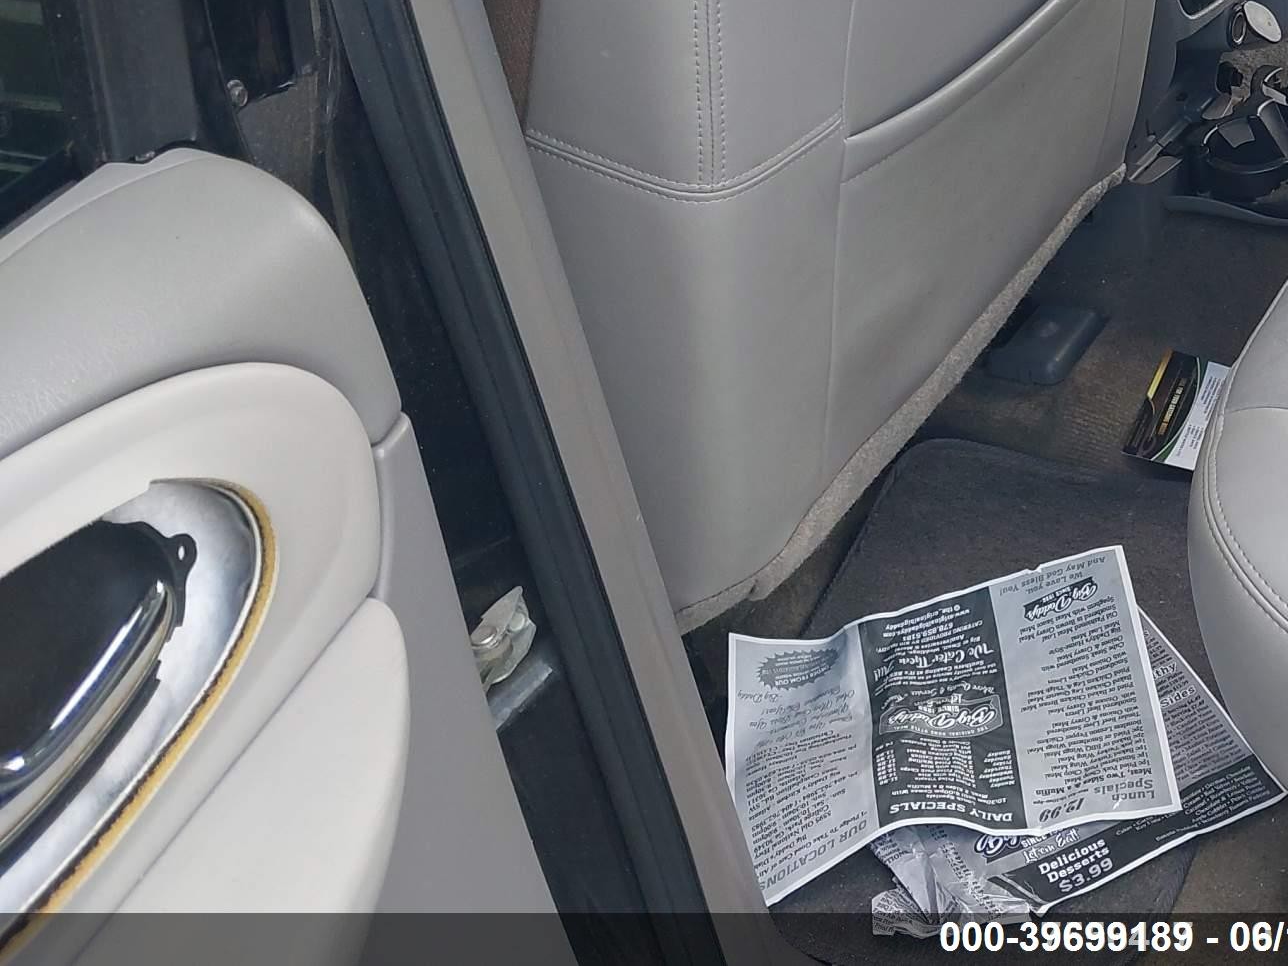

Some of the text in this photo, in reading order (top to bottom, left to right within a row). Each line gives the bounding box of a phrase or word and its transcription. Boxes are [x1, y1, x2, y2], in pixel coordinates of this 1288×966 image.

[1086, 555, 1106, 567] And
[1045, 567, 1064, 579] God
[1064, 561, 1085, 575] May
[1044, 570, 1082, 587] We Love
[1069, 582, 1098, 603] Big
[1054, 611, 1071, 621] Meat
[1071, 606, 1086, 616] with
[1105, 610, 1118, 619] Old
[1018, 603, 1116, 643] Smothered Brown Gravy Meal
[1018, 624, 1036, 635] Meal
[1056, 626, 1073, 636] Meat
[1087, 625, 1103, 636] Loaf
[1070, 631, 1087, 642] Meal
[931, 649, 965, 663] Cater
[967, 642, 994, 659] We
[1055, 645, 1093, 661] Gravy Meal
[1111, 650, 1127, 660] with
[898, 654, 931, 669] Them
[1055, 653, 1090, 668] Smothered
[1040, 664, 1055, 672] with
[1067, 657, 1128, 680] Smothered Chicken
[1071, 663, 1088, 673] Meal
[1086, 672, 1112, 684] Chicken
[1084, 680, 1111, 691] Chicken
[1026, 688, 1044, 698] Meal
[1059, 693, 1086, 703] Chicken
[1158, 686, 1197, 707] Sides
[1027, 695, 1043, 704] Meal
[1047, 690, 1135, 715] with Gravy Meal
[1102, 696, 1137, 710] Smothered
[1123, 704, 1139, 713] with
[955, 705, 995, 727] Big
[1069, 715, 1090, 725] Gravy
[1046, 724, 1081, 735] Smothered
[1051, 720, 1068, 729] Meal
[1036, 735, 1064, 744] Chicken
[1067, 735, 1103, 749] Smothered
[1043, 749, 1061, 758] Meal
[1061, 746, 1083, 754] Wings
[1075, 749, 1095, 759] Wing
[1057, 754, 1075, 764] Meal
[1068, 760, 1088, 768] Wing
[1044, 753, 1136, 779] Smothered Chop Meal
[1050, 763, 1067, 772] Meal
[1063, 760, 1137, 784] Fried Pork Chop Meal
[1082, 774, 1104, 785] Sides
[1106, 770, 1124, 779] Two
[1035, 786, 1065, 796] Muffin
[1093, 777, 1153, 794] Specials
[1111, 789, 1155, 801] Lunch
[889, 800, 1012, 822] DAILY SPECIALS
[1038, 797, 1084, 822] 12.99
[800, 819, 814, 832] Old
[838, 818, 867, 843] OUR
[770, 828, 800, 849] National
[1038, 839, 1105, 874] Delicious
[1046, 847, 1109, 882] Desserts
[1058, 857, 1112, 892] $3.99
